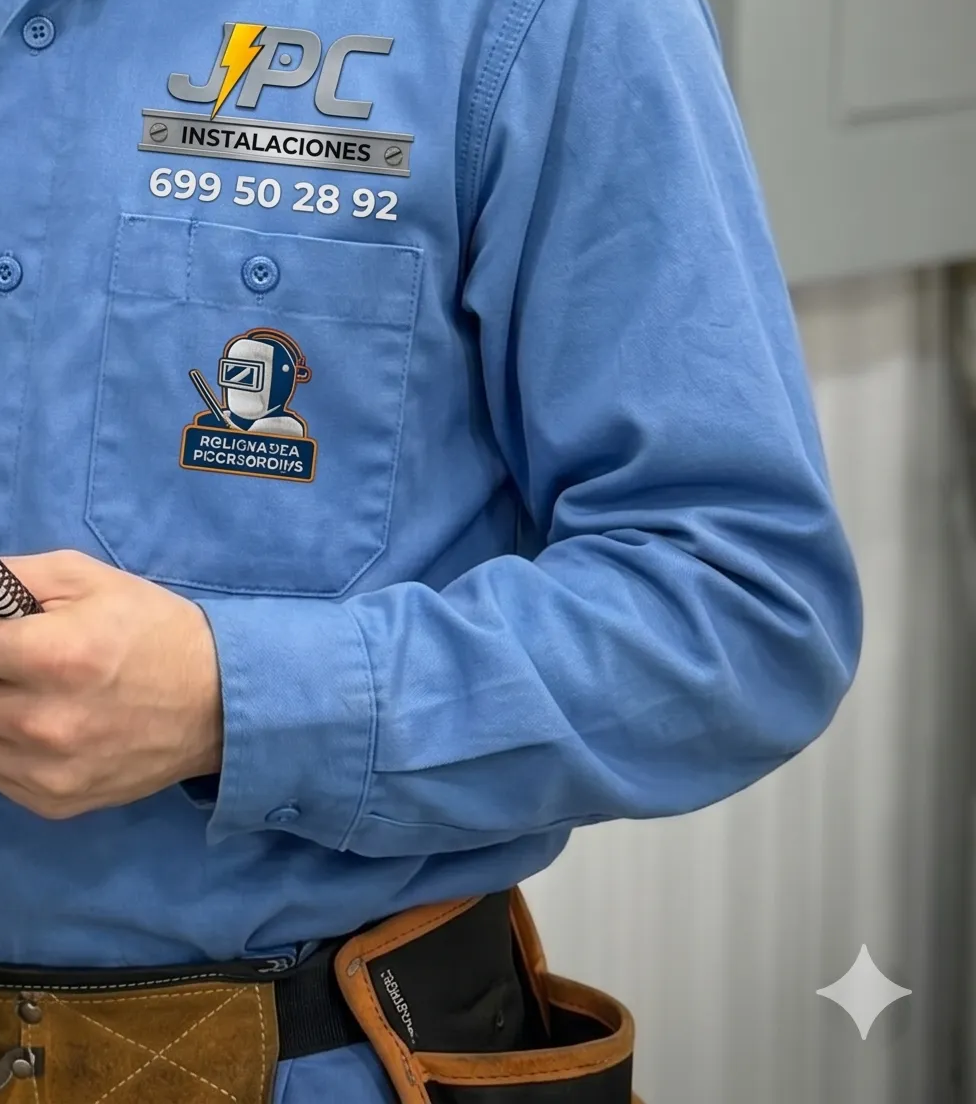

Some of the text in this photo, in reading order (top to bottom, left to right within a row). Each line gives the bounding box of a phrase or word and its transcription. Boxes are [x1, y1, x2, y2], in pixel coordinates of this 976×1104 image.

[167, 21, 394, 120] JPC
[181, 125, 371, 163] INSTALACIONES
[149, 167, 398, 221] 699 50 28 92
